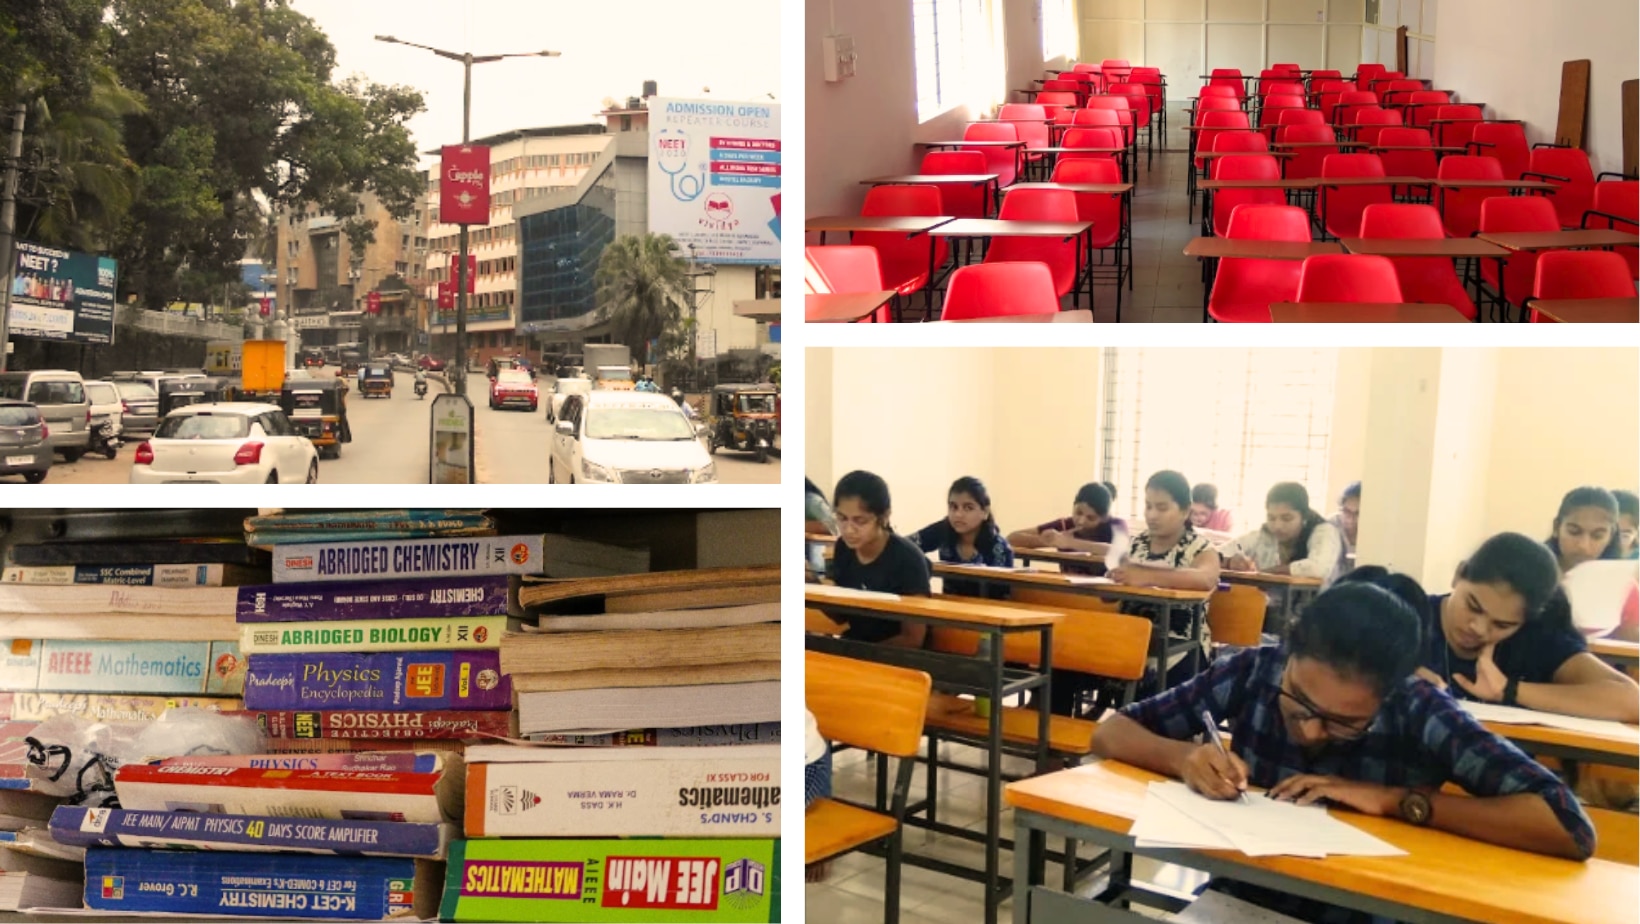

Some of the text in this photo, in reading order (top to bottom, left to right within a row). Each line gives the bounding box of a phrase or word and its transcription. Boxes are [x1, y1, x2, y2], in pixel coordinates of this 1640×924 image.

[667, 103, 770, 118] ADMISSION OPEN
[667, 115, 769, 128] REPEATER COURSE
[659, 139, 685, 149] NEET
[20, 253, 50, 271] NEET
[286, 557, 312, 568] DINESH
[318, 547, 388, 575] ABRIDGED
[393, 543, 479, 573] CHEMISTRY
[495, 548, 504, 562] XII
[100, 567, 113, 577] SSC
[115, 566, 151, 577] Combined
[103, 576, 146, 585] Matric-Level
[430, 587, 484, 603] CHEMISTRY
[254, 633, 278, 642] DINESH
[281, 629, 363, 645] ABRIDGED
[370, 627, 442, 644] BIOLOGY
[458, 626, 468, 641] XII
[48, 652, 201, 677] AIEEE Mathematics
[249, 672, 295, 691] Pradeep's
[303, 661, 381, 688] Physics
[416, 666, 433, 696] JEE
[301, 685, 384, 702] Encyclopedia
[296, 713, 314, 737] NEET
[330, 712, 423, 729] PHYSICS
[428, 717, 478, 733] Pradeep's
[331, 729, 424, 737] OBJECTIVE
[158, 766, 239, 776] CHEMISTRY
[250, 758, 318, 769] PHYSICS
[380, 762, 397, 771] Rao
[706, 773, 770, 782] FOR CLASS XI
[567, 790, 597, 799] VERMA
[599, 790, 624, 798] RAMA
[678, 786, 781, 809] athematics
[700, 812, 772, 824] S. CHAND'S
[121, 813, 139, 827] JEE
[171, 817, 202, 831] AIPMT
[204, 817, 245, 834] PHYSICS
[245, 820, 266, 838] 40
[268, 824, 293, 838] DAYS
[295, 825, 327, 840] SCORE
[328, 827, 378, 844] AMPLIFIER
[221, 876, 272, 889] Examinations
[327, 880, 342, 891] CET
[344, 880, 356, 891] For
[466, 864, 579, 894] MATHEMATICS
[583, 858, 599, 904] AIEEE
[608, 859, 718, 906] JEE Main
[138, 881, 198, 897] R.C. Grover
[219, 891, 355, 912] K-CET CHEMISTRY
